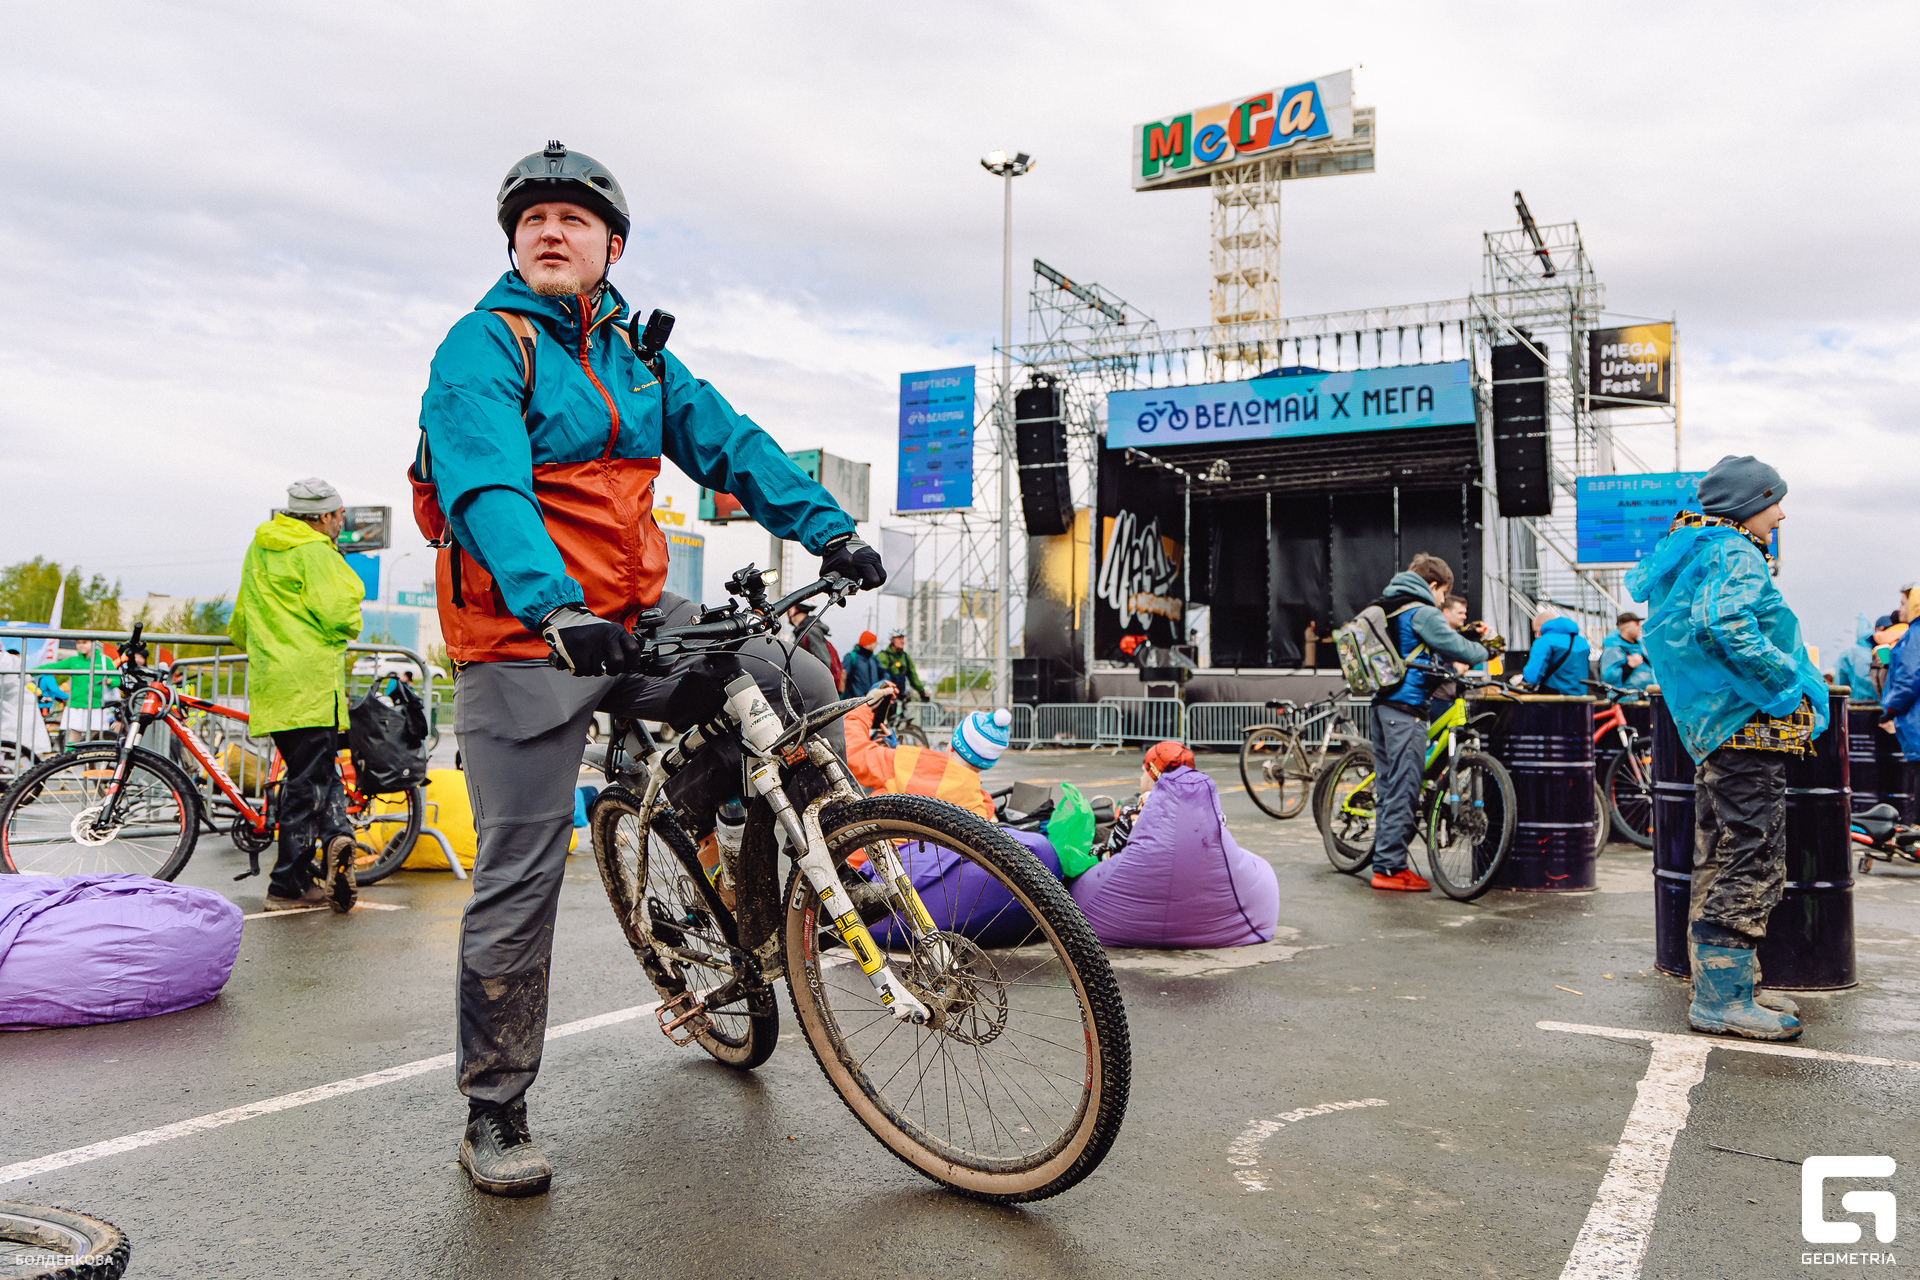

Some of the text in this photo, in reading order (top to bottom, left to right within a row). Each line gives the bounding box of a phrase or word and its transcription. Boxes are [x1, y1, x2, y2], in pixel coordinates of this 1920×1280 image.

[1600, 342, 1657, 359] MEGA
[1600, 360, 1658, 376] Urban
[1600, 378, 1641, 394] Fest
[1196, 388, 1318, 430] ВЕЛОМАЙ
[1363, 385, 1434, 417] МЕГА
[76, 751, 116, 760] MERID
[953, 734, 972, 759] 2024
[178, 722, 244, 797] MERIDA
[827, 823, 878, 850] RABBIT
[792, 880, 807, 910] CST
